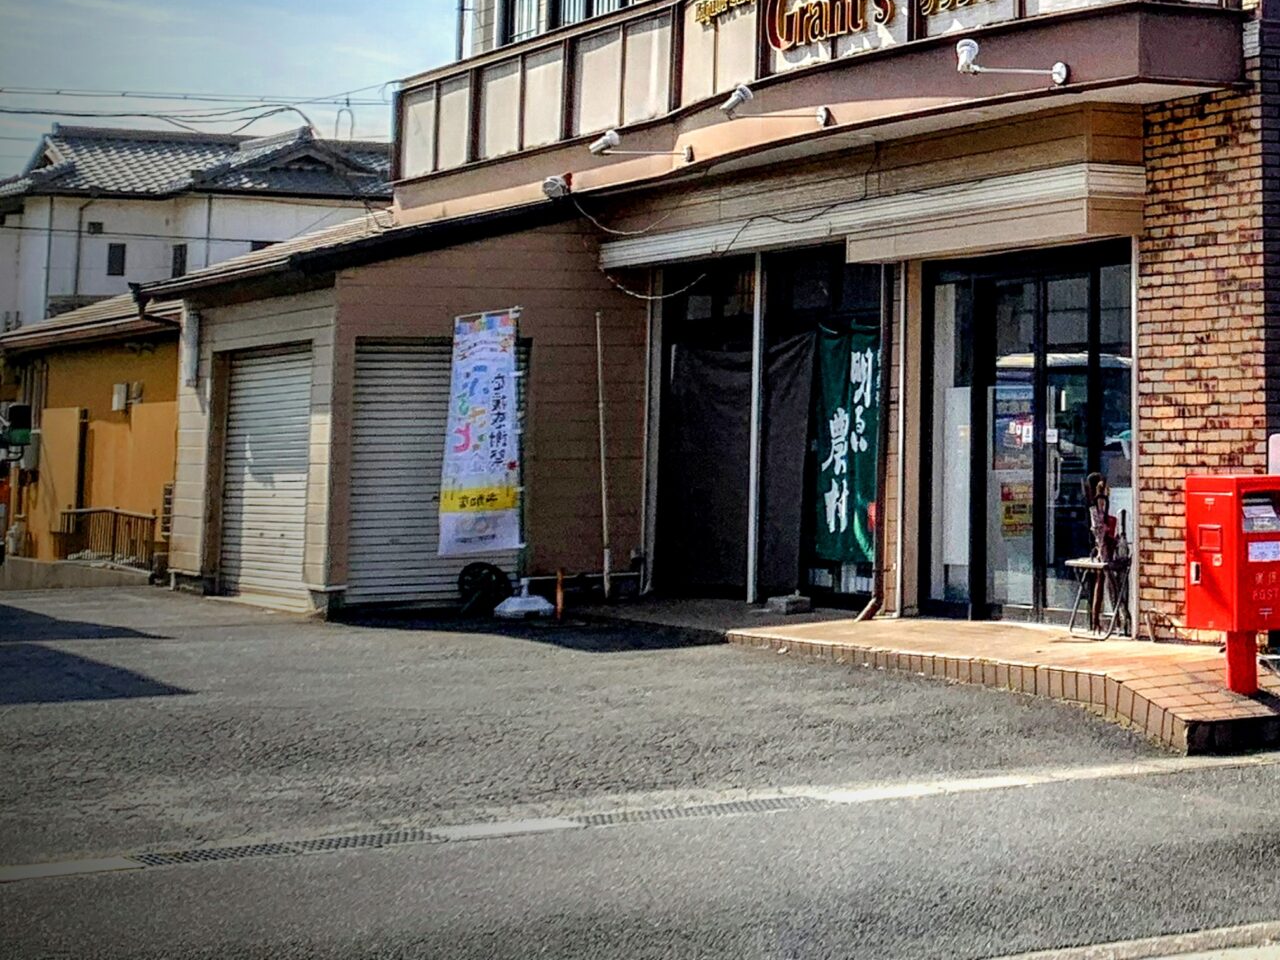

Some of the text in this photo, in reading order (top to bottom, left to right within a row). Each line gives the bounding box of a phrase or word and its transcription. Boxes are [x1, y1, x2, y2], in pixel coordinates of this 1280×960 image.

[849, 347, 873, 452] 明るい
[822, 406, 849, 534] 農村
